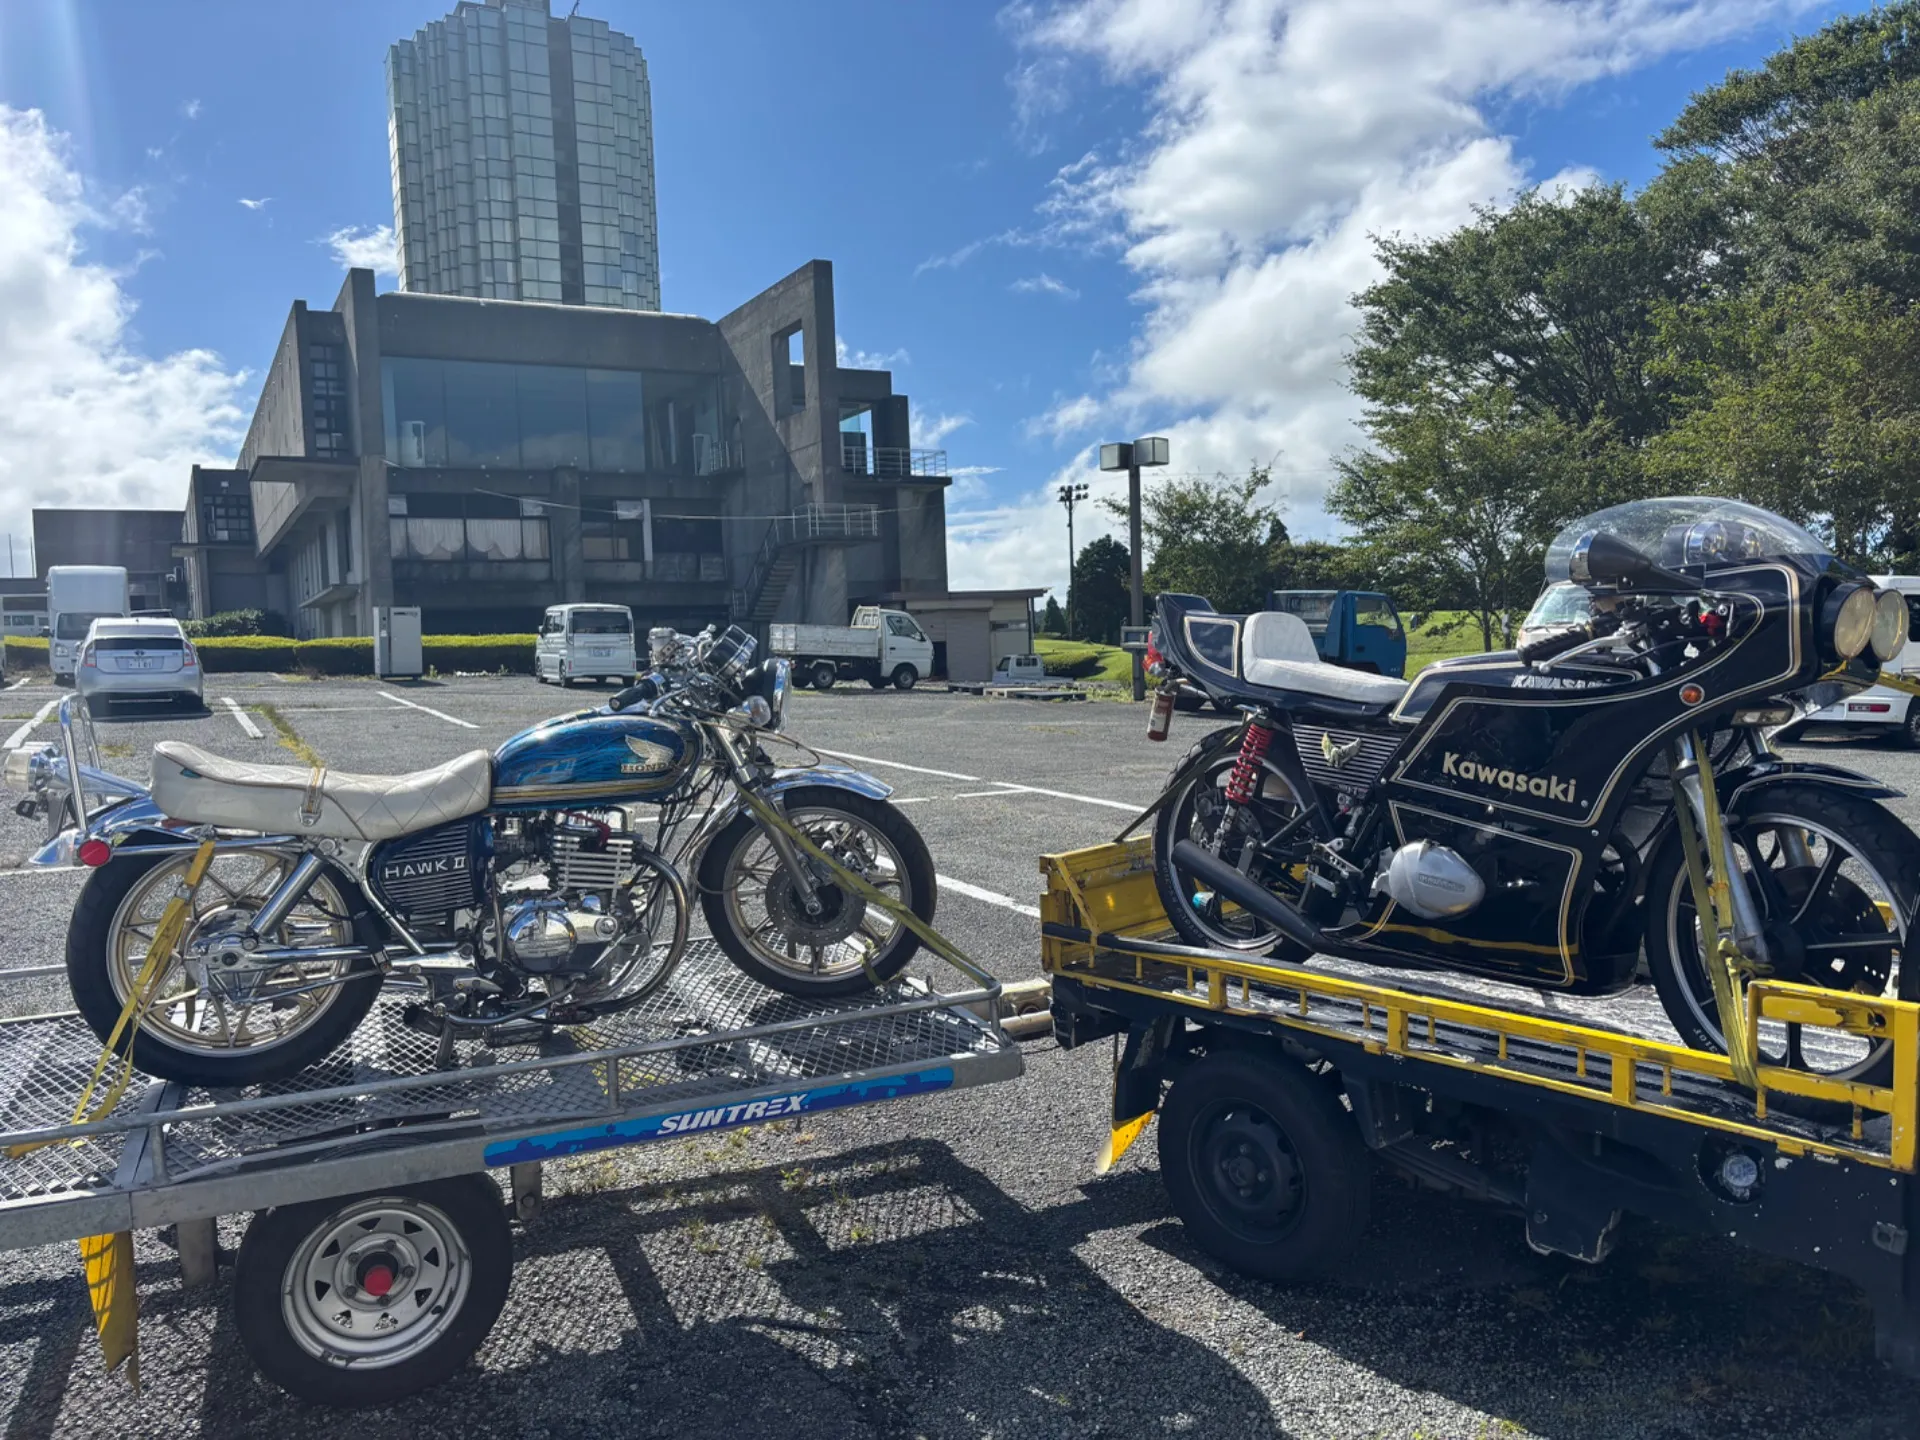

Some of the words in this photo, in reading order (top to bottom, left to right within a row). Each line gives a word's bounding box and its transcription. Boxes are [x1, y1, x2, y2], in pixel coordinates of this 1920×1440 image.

[1442, 751, 1577, 803] Kawasaki
[385, 859, 449, 879] HAWK
[656, 1093, 808, 1136] SUNTREX
